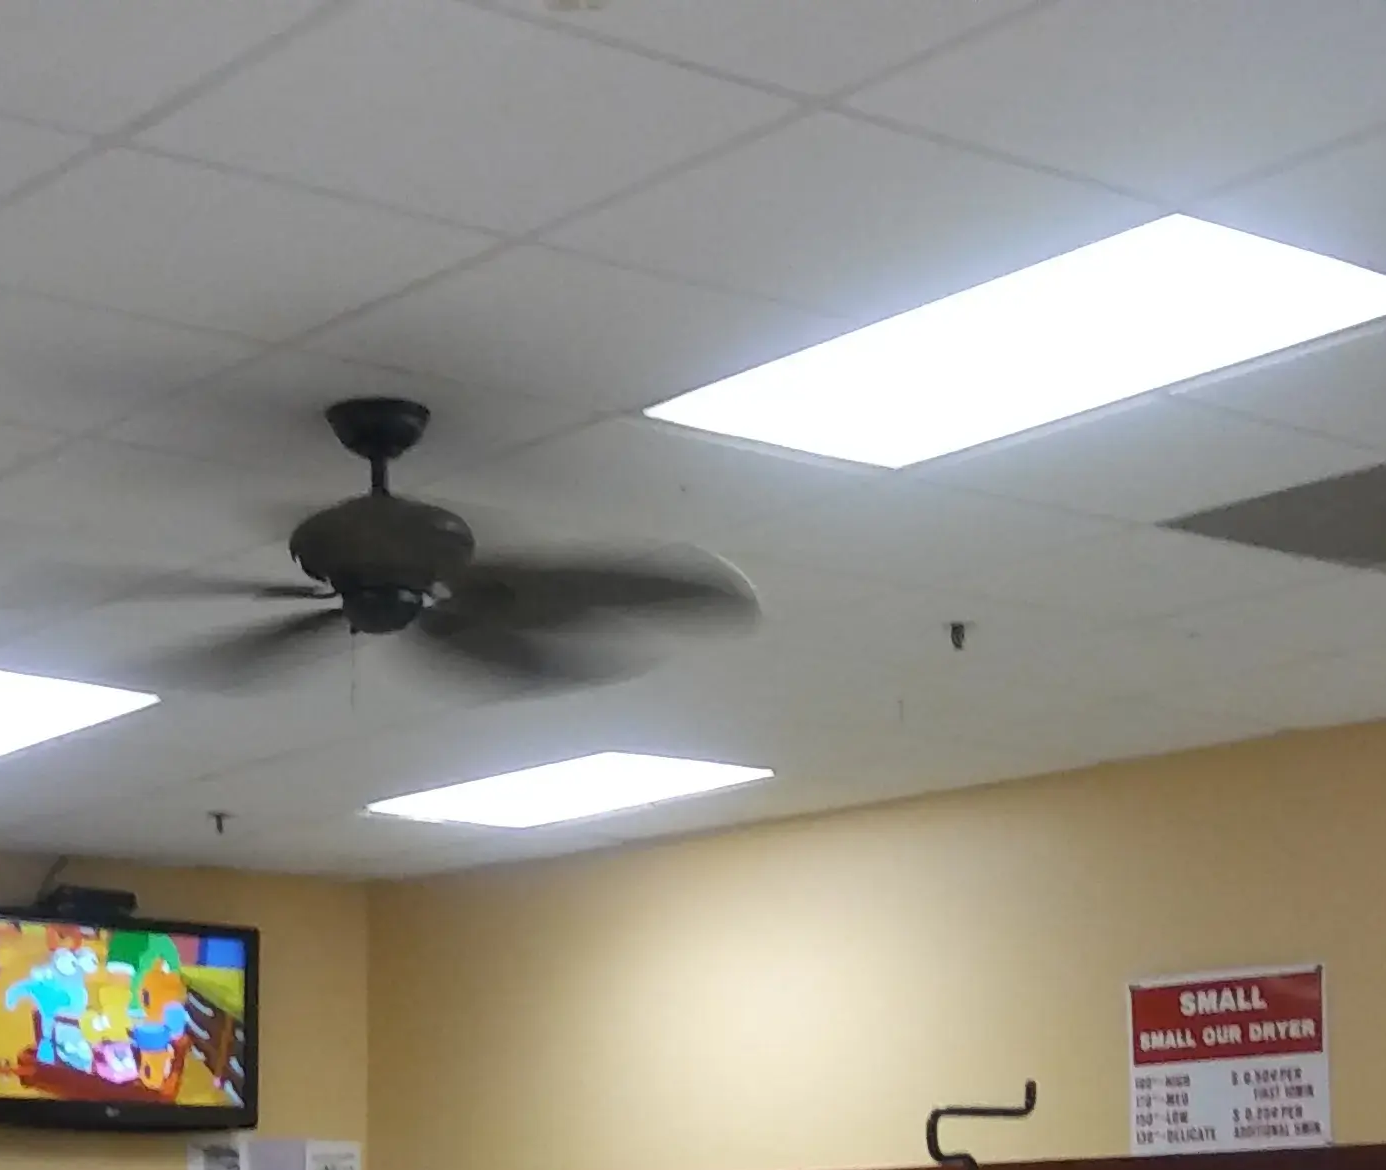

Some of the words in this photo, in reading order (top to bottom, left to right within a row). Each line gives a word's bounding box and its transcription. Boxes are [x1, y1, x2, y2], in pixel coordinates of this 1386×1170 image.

[1179, 985, 1268, 1016] SMALL
[1139, 1028, 1197, 1053] SMALL
[1201, 1024, 1243, 1047] OUR
[1249, 1017, 1317, 1042] DRYER
